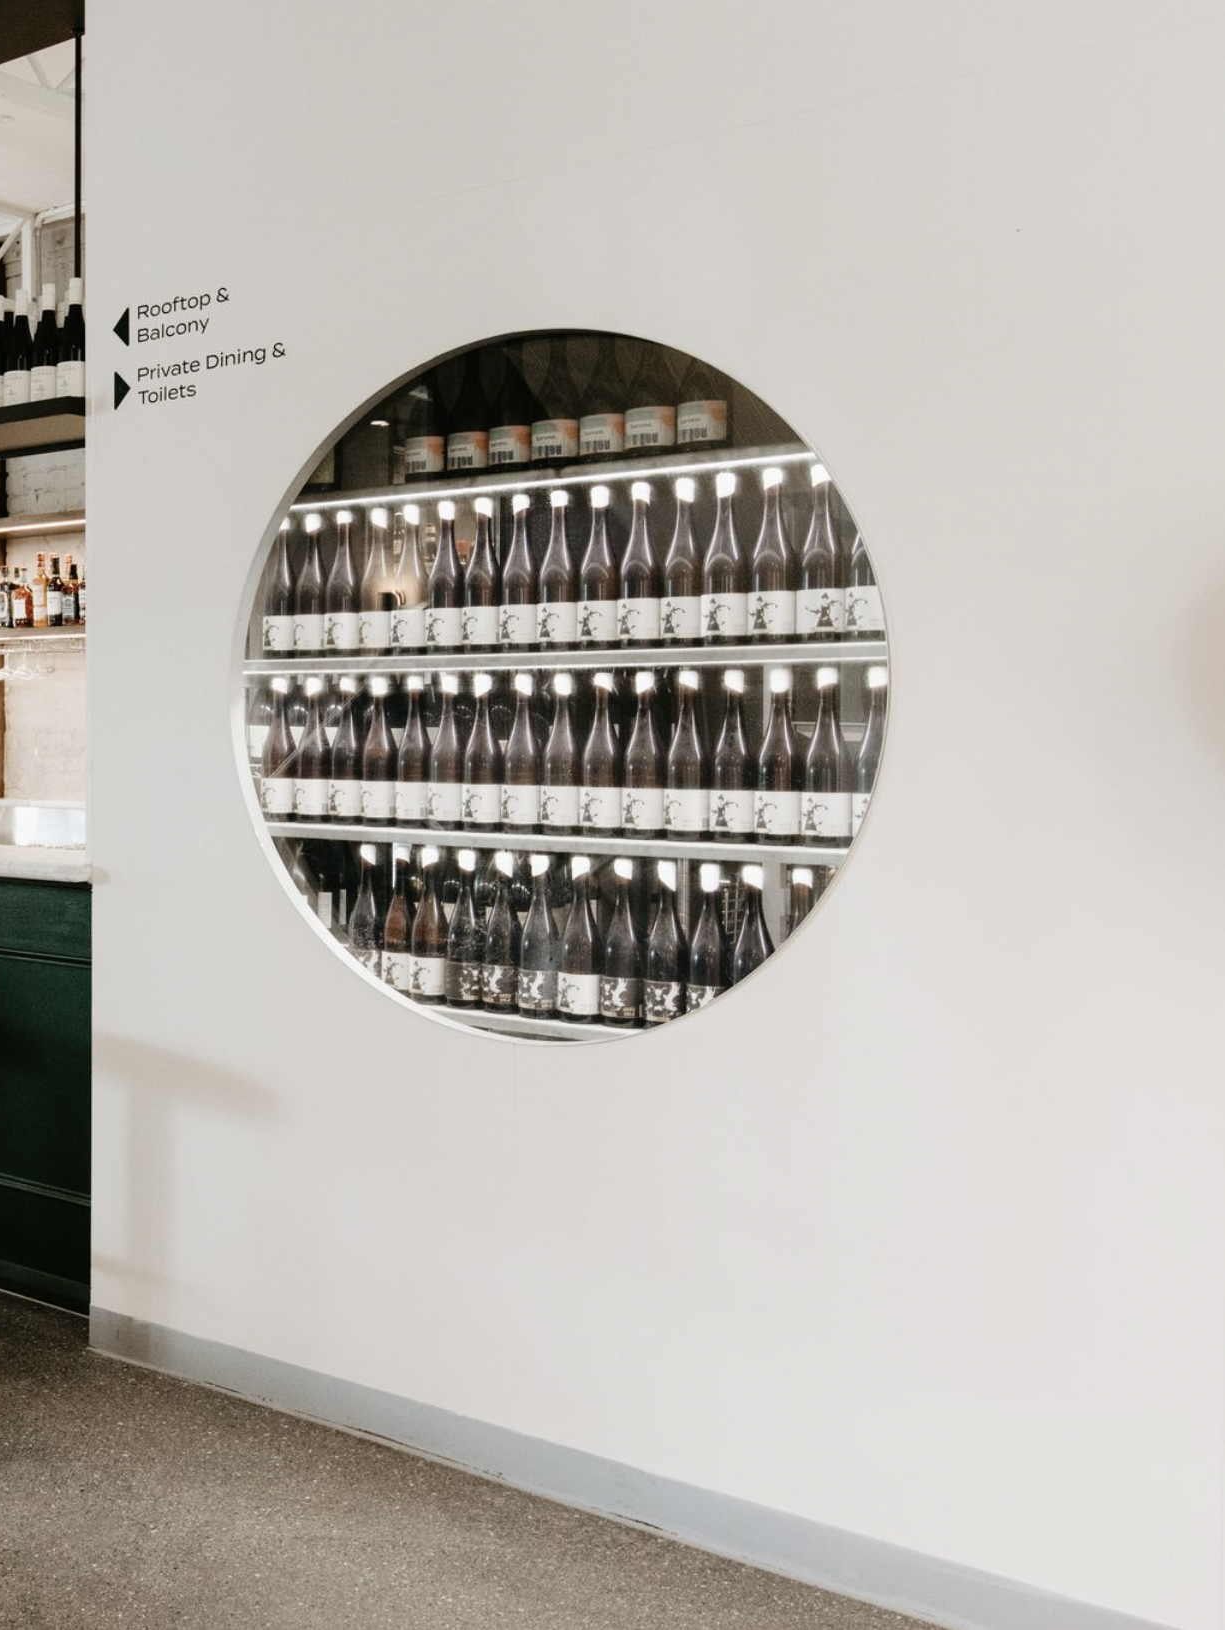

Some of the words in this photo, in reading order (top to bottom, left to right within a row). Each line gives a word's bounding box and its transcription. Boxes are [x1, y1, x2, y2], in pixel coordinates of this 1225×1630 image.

[138, 294, 211, 319] Rooftop
[216, 287, 229, 303] &
[138, 318, 209, 343] Balcony
[138, 360, 200, 382] Private
[206, 348, 266, 370] Dining
[272, 342, 286, 358] &
[138, 385, 196, 405] Toilets
